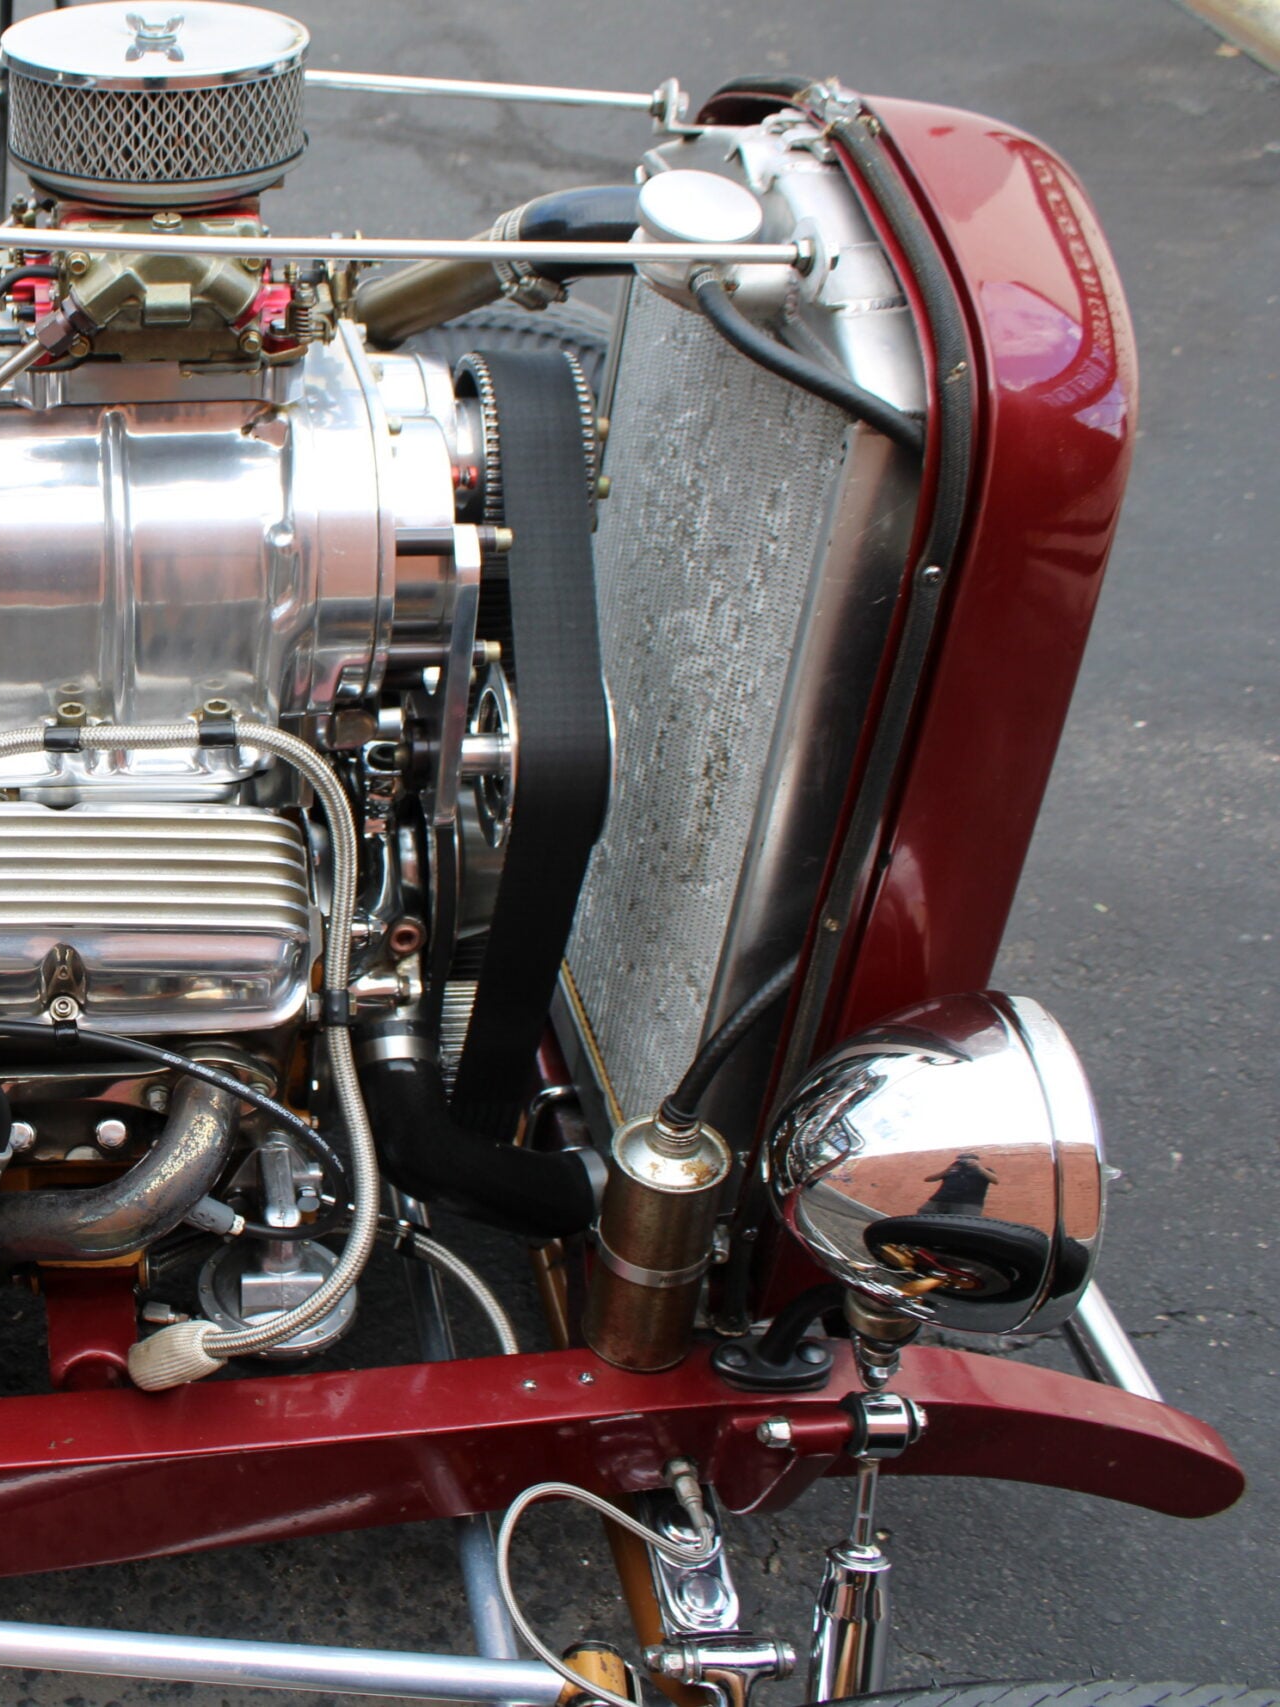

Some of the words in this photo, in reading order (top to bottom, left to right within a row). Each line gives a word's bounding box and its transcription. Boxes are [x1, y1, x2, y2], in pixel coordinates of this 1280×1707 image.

[162, 1053, 182, 1064] MSD
[221, 1077, 250, 1093] SUPER
[256, 1094, 305, 1127] CONDUCTOR
[308, 1130, 331, 1151] SPARK
